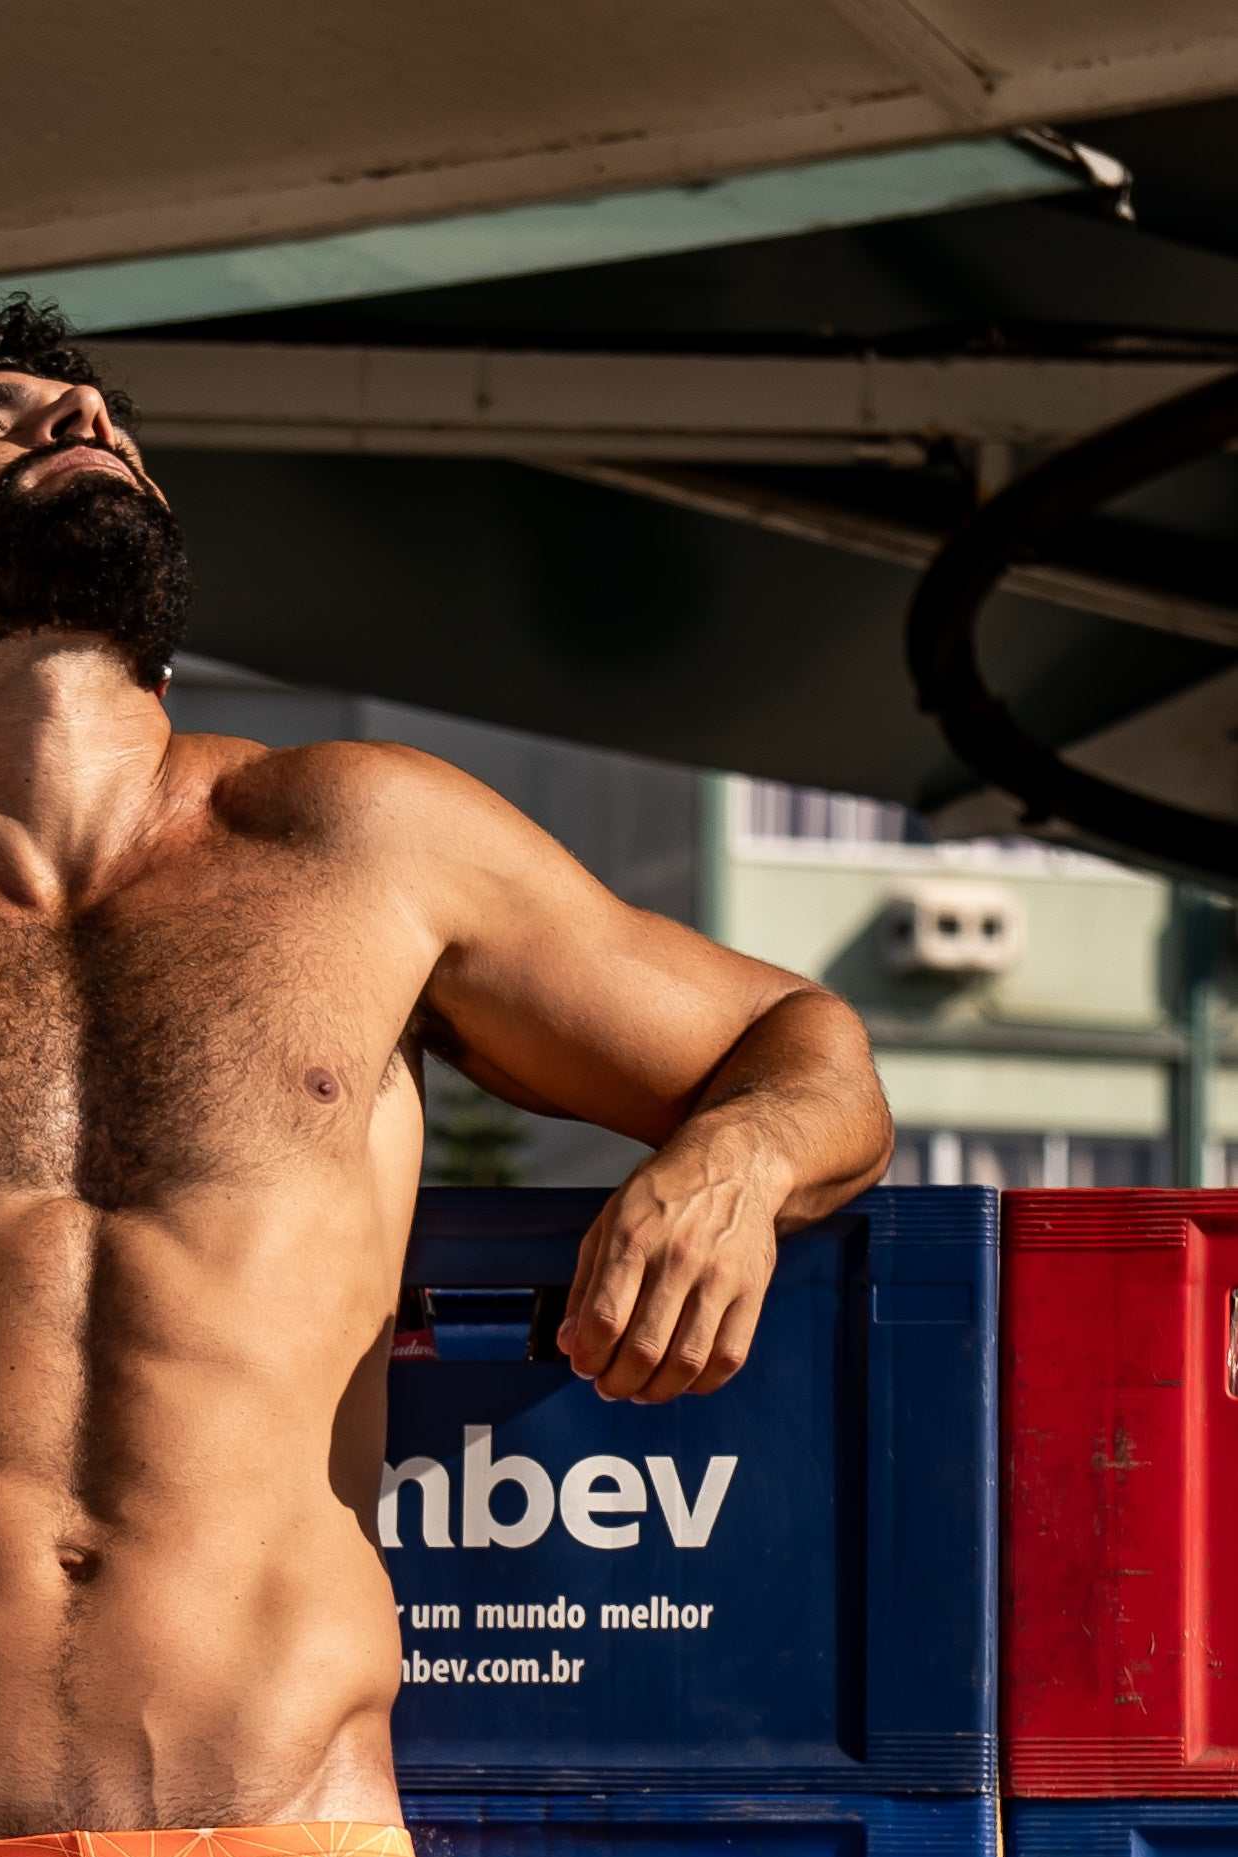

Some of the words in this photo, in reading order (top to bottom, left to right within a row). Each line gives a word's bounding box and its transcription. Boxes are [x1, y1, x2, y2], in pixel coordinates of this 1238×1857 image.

[376, 1424, 739, 1549] mbev
[411, 1603, 461, 1630] um
[475, 1595, 587, 1630] mundo
[600, 1595, 714, 1630] melhor
[401, 1649, 585, 1684] bev.com.br
